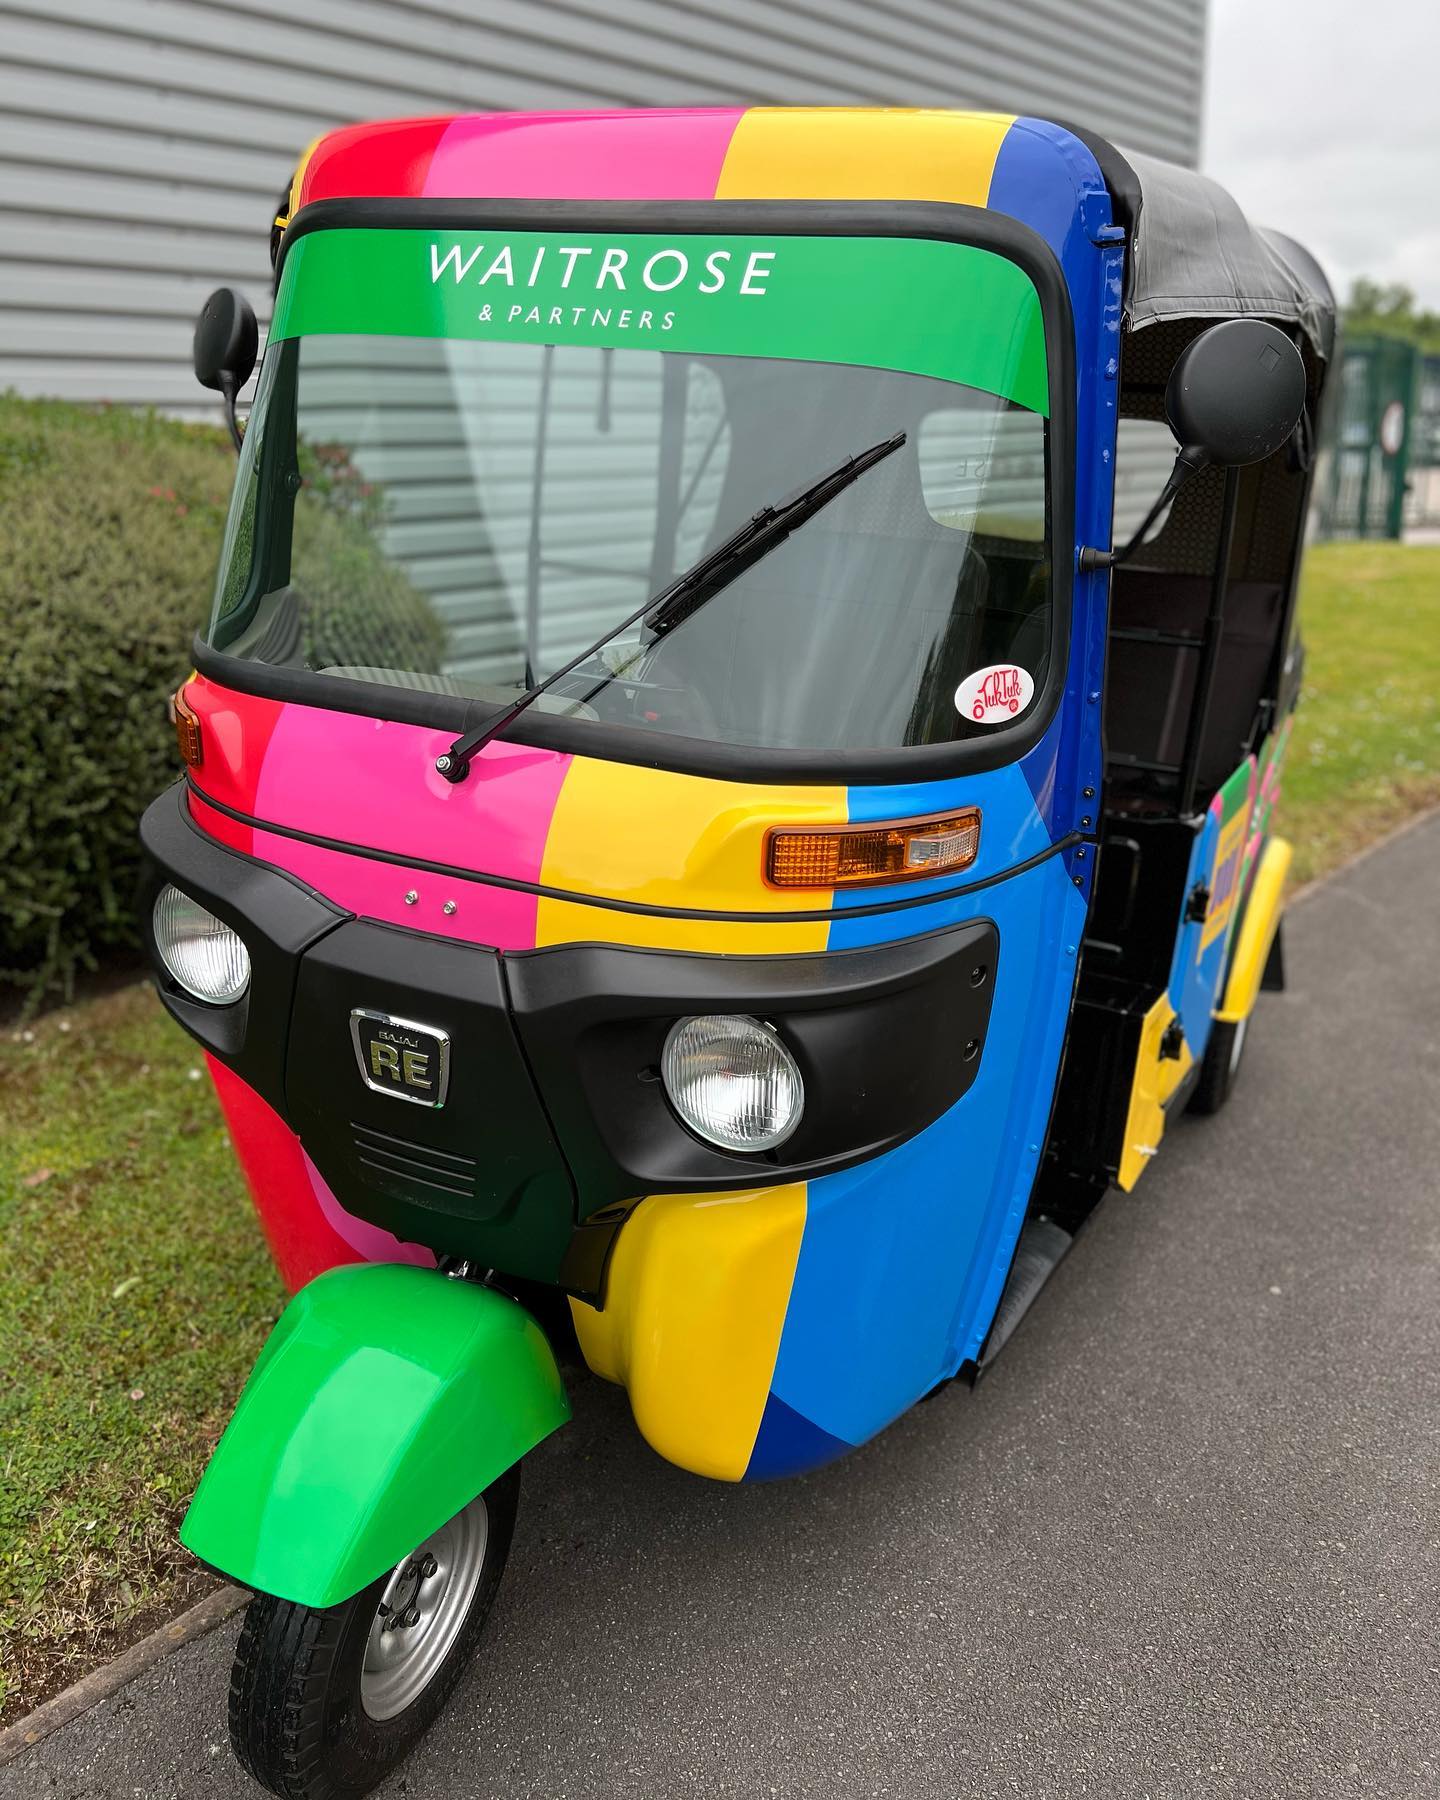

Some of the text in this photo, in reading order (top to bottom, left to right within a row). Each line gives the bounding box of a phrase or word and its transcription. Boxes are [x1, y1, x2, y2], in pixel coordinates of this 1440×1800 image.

[430, 244, 776, 295] WAITROSE
[478, 304, 676, 330] & PARTNERS
[379, 1031, 419, 1048] BAJAJ
[370, 1040, 433, 1090] RE
